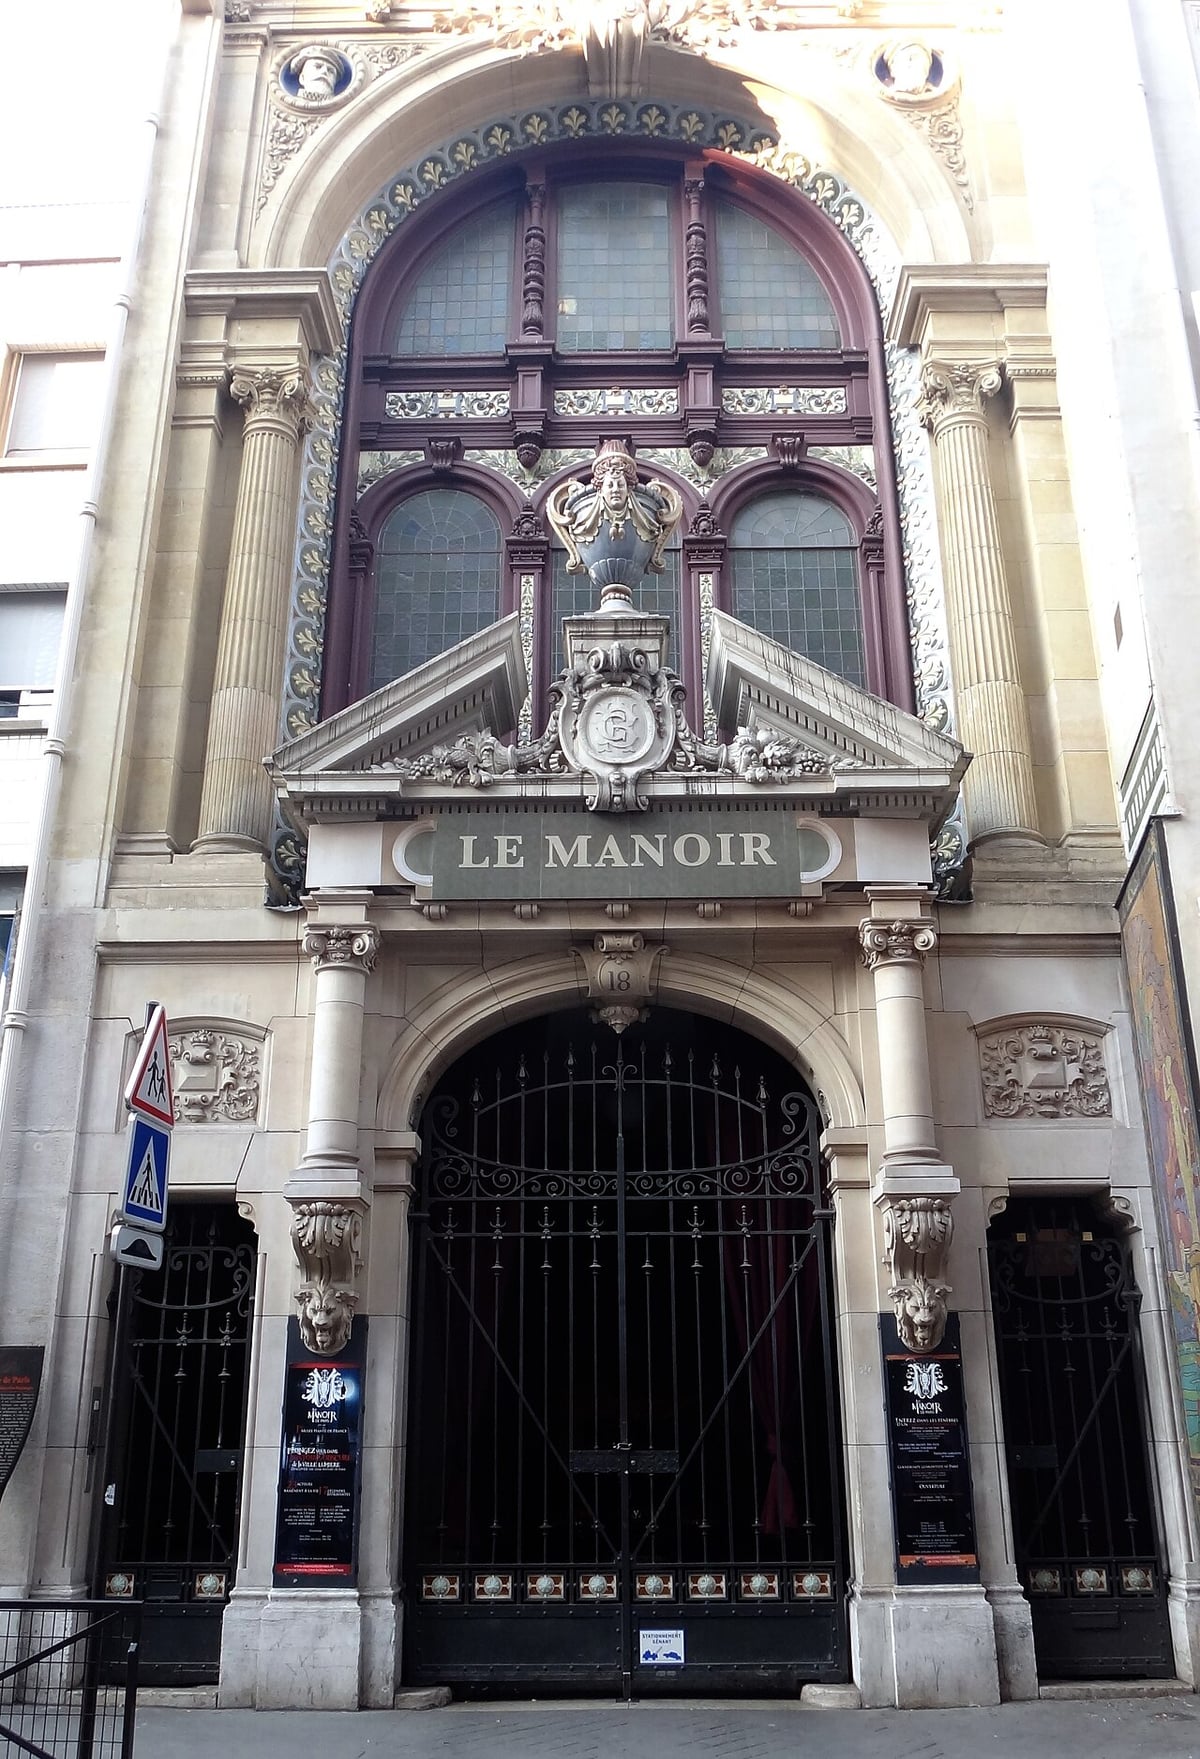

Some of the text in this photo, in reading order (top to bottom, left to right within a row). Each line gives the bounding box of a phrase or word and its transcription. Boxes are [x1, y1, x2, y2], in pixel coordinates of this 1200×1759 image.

[458, 833, 777, 869] LE MANOIR
[608, 970, 631, 992] 18
